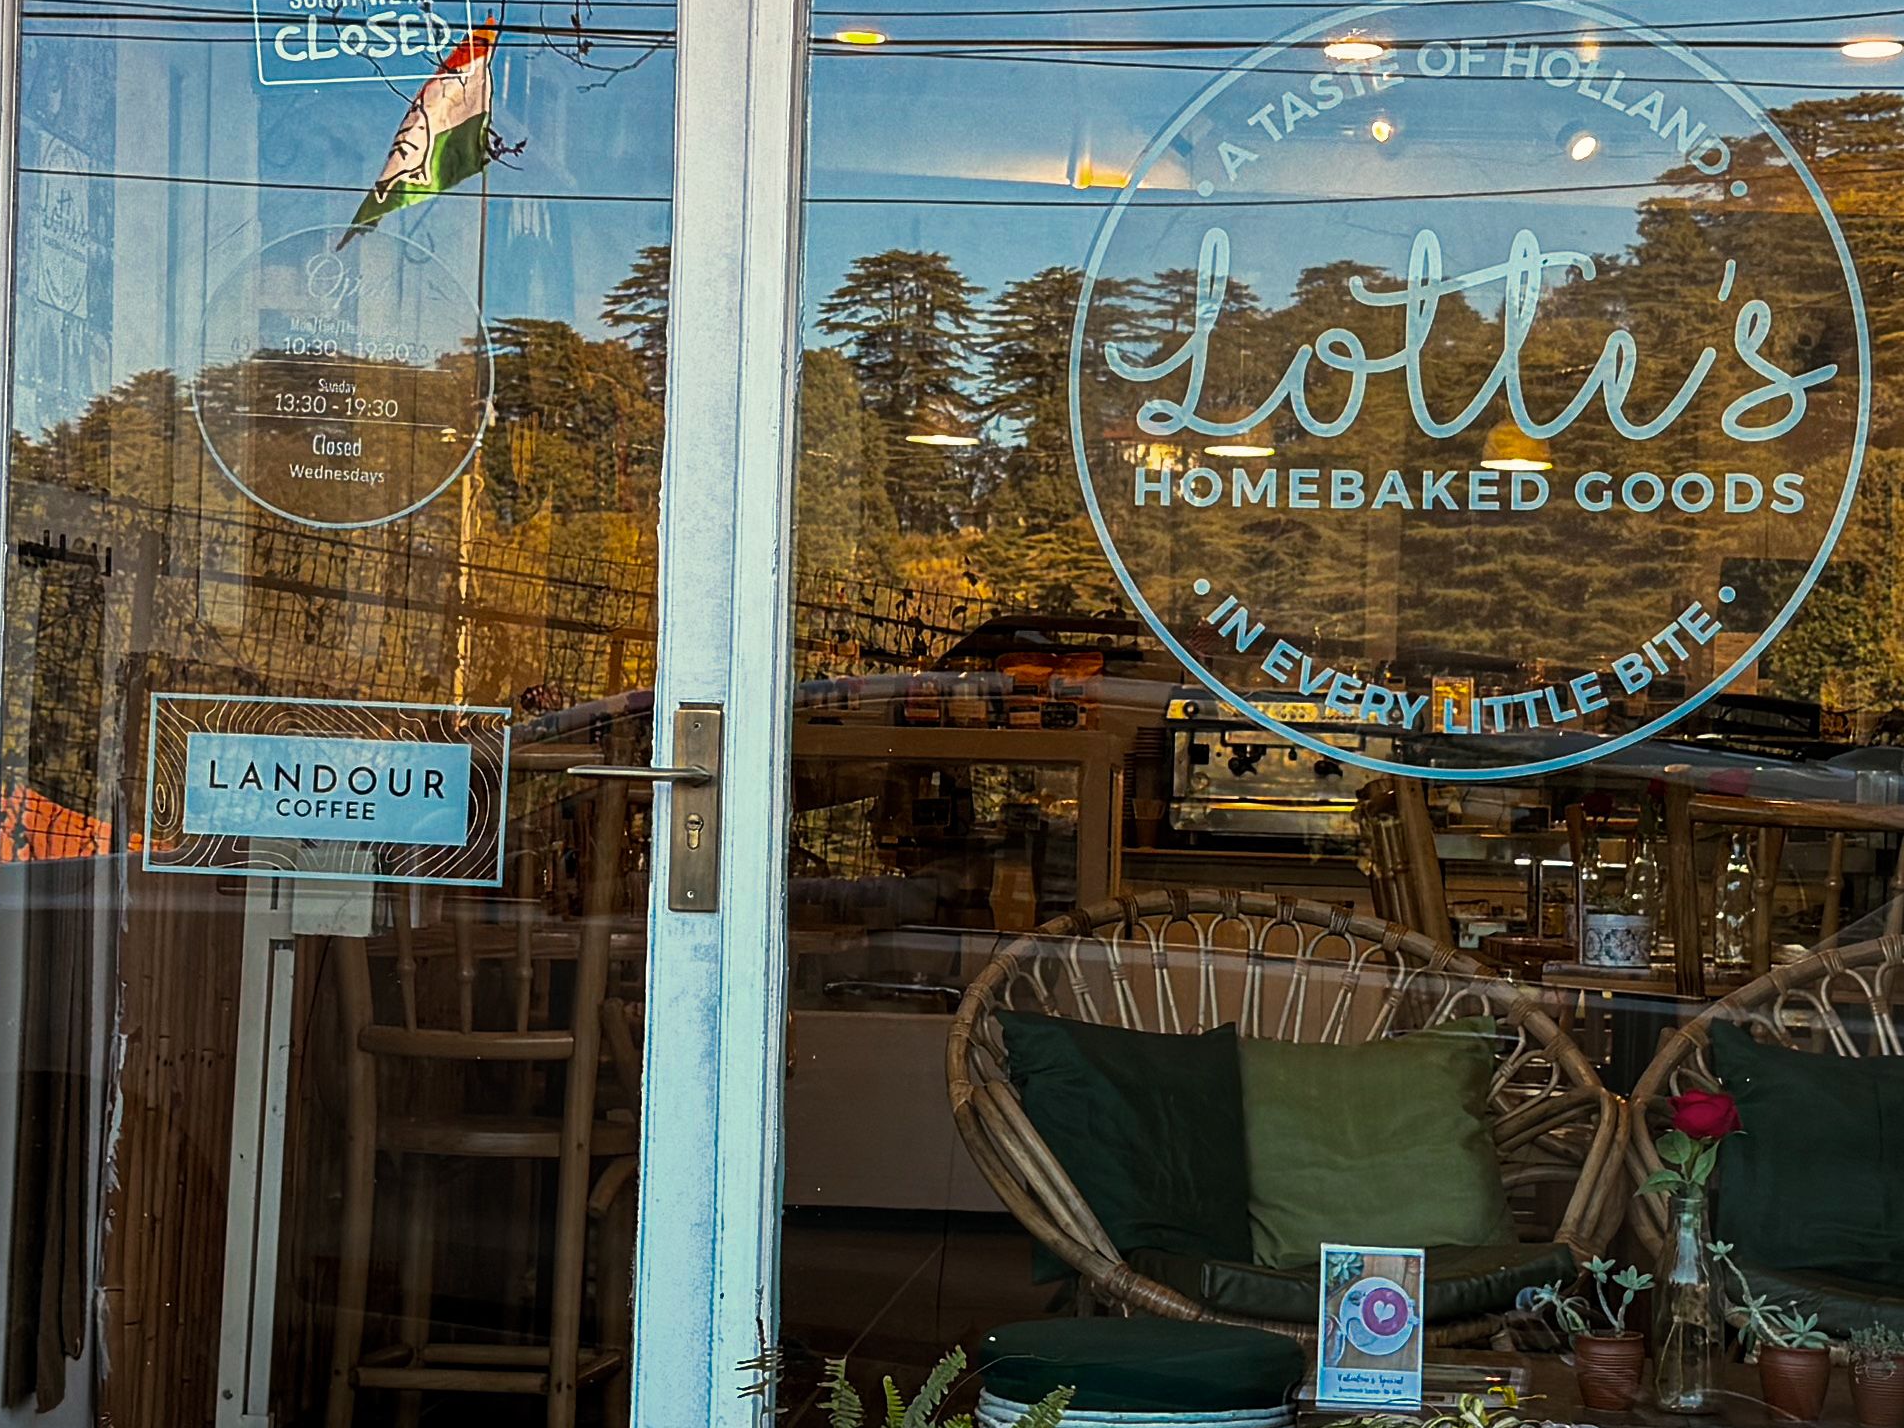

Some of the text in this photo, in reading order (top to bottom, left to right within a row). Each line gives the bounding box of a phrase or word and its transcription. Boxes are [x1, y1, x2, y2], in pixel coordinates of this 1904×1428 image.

[1216, 39, 1732, 181] A TASTE OF HOLLAND
[1105, 227, 1838, 442] Lotte's
[282, 336, 338, 357] 10:30
[355, 340, 410, 362] 19:30
[318, 378, 358, 396] Sunday
[274, 393, 327, 414] 13:30
[344, 397, 399, 418] 19:30
[312, 433, 363, 457] Closed
[289, 463, 385, 486] Wednesdays
[1135, 465, 1806, 515] HOMEBAKED GOODS
[1206, 594, 1723, 735] IN EVERY LITTLE BITE
[208, 759, 445, 799] LANDOUR
[276, 797, 376, 821] COFFEE
